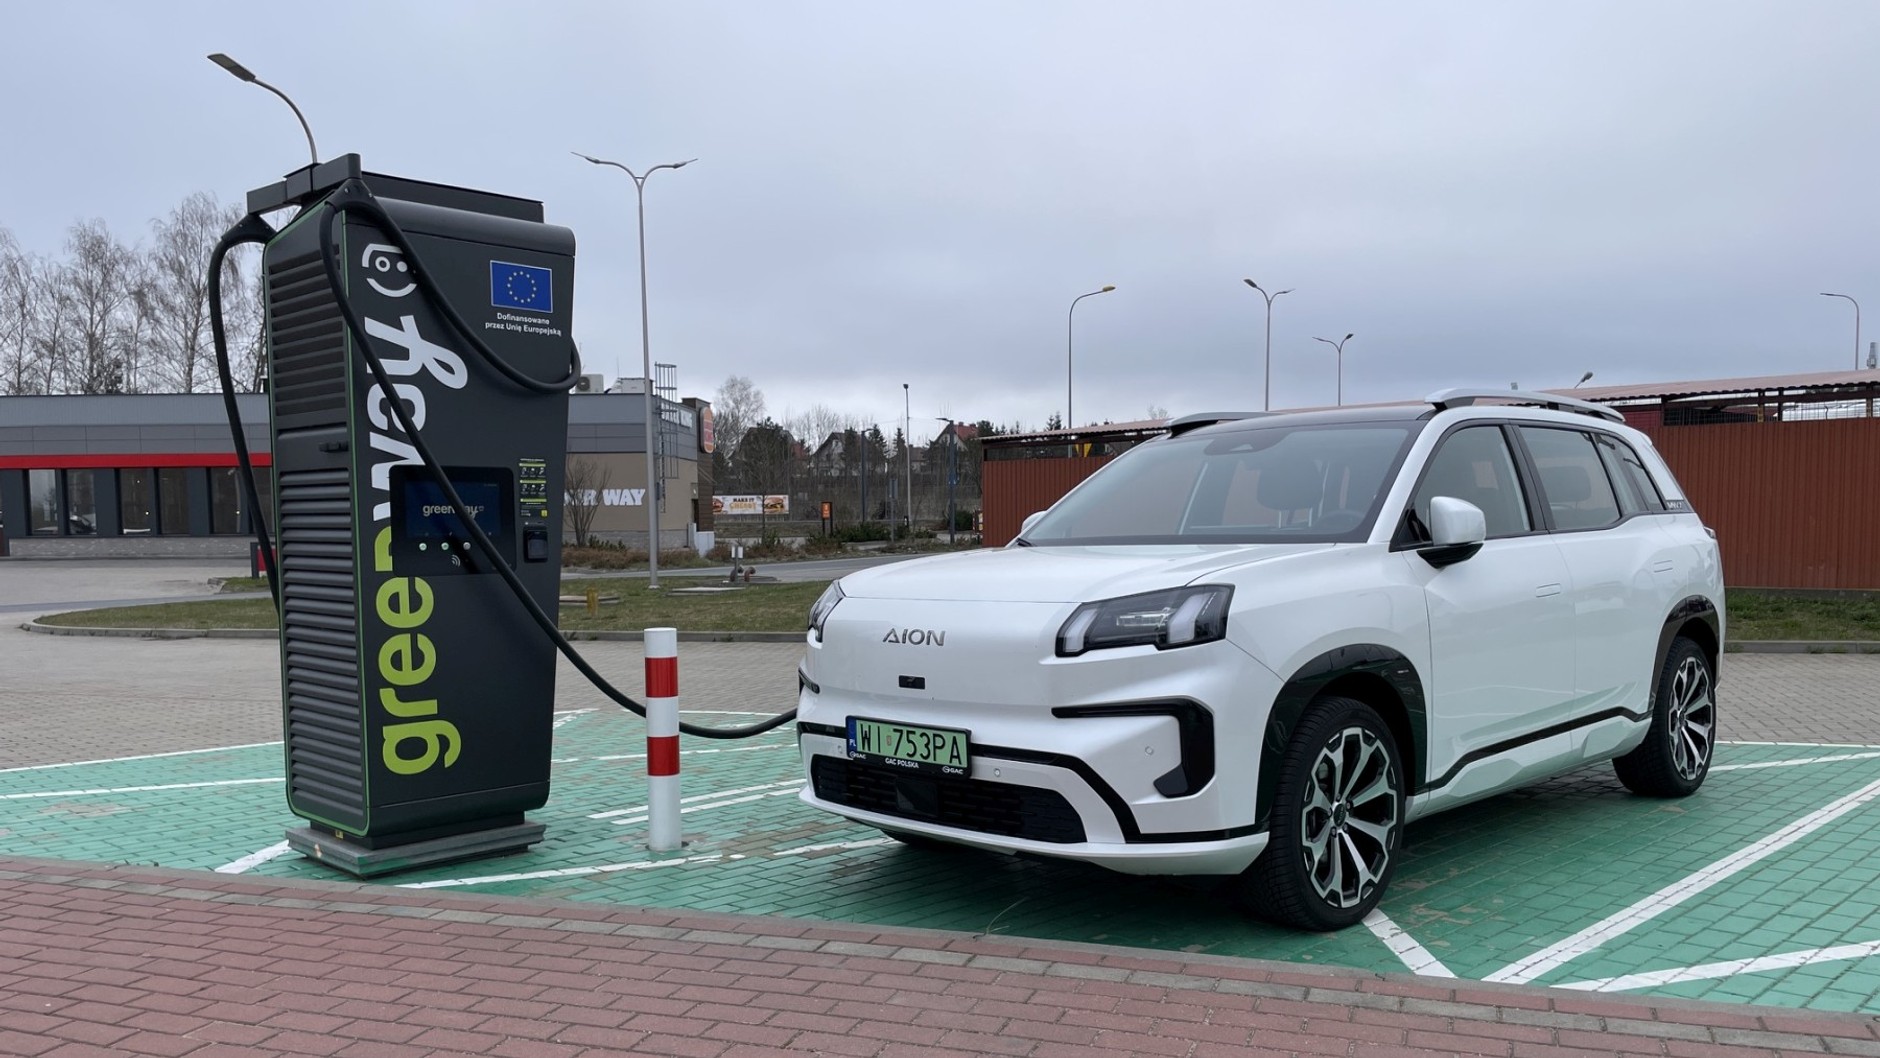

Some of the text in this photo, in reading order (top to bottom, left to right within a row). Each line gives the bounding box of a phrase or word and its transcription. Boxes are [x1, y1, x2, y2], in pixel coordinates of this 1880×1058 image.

[497, 312, 550, 325] Dofinansowane
[485, 322, 562, 337] przez Unię Europejską
[602, 488, 646, 506] WAY
[882, 628, 946, 647] AION
[849, 738, 857, 747] PL
[860, 723, 962, 765] WI 753PA
[885, 757, 919, 769] GAC POLSKA
